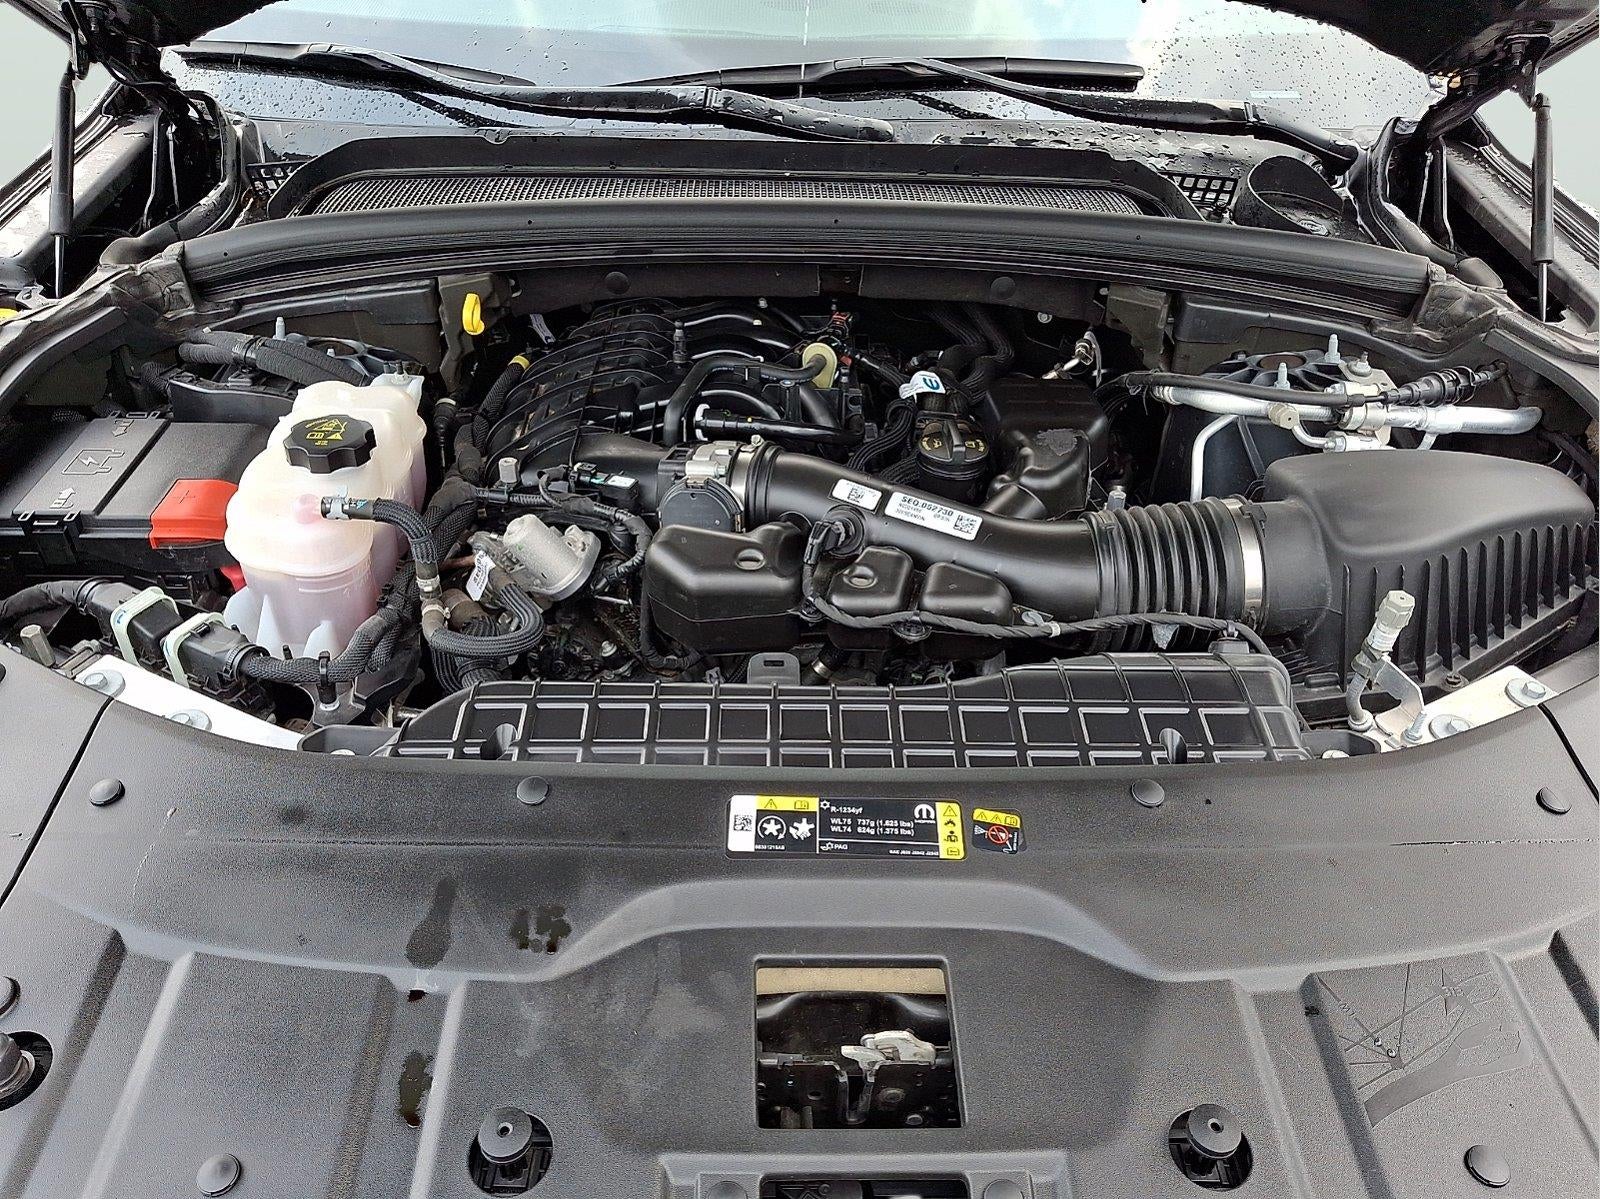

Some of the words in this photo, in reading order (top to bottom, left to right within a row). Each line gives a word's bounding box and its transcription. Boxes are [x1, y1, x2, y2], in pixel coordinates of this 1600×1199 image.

[830, 806, 863, 814] R-1234yf
[857, 819, 875, 827] 737g
[857, 827, 875, 835] 624g
[876, 827, 899, 836] (1.375
